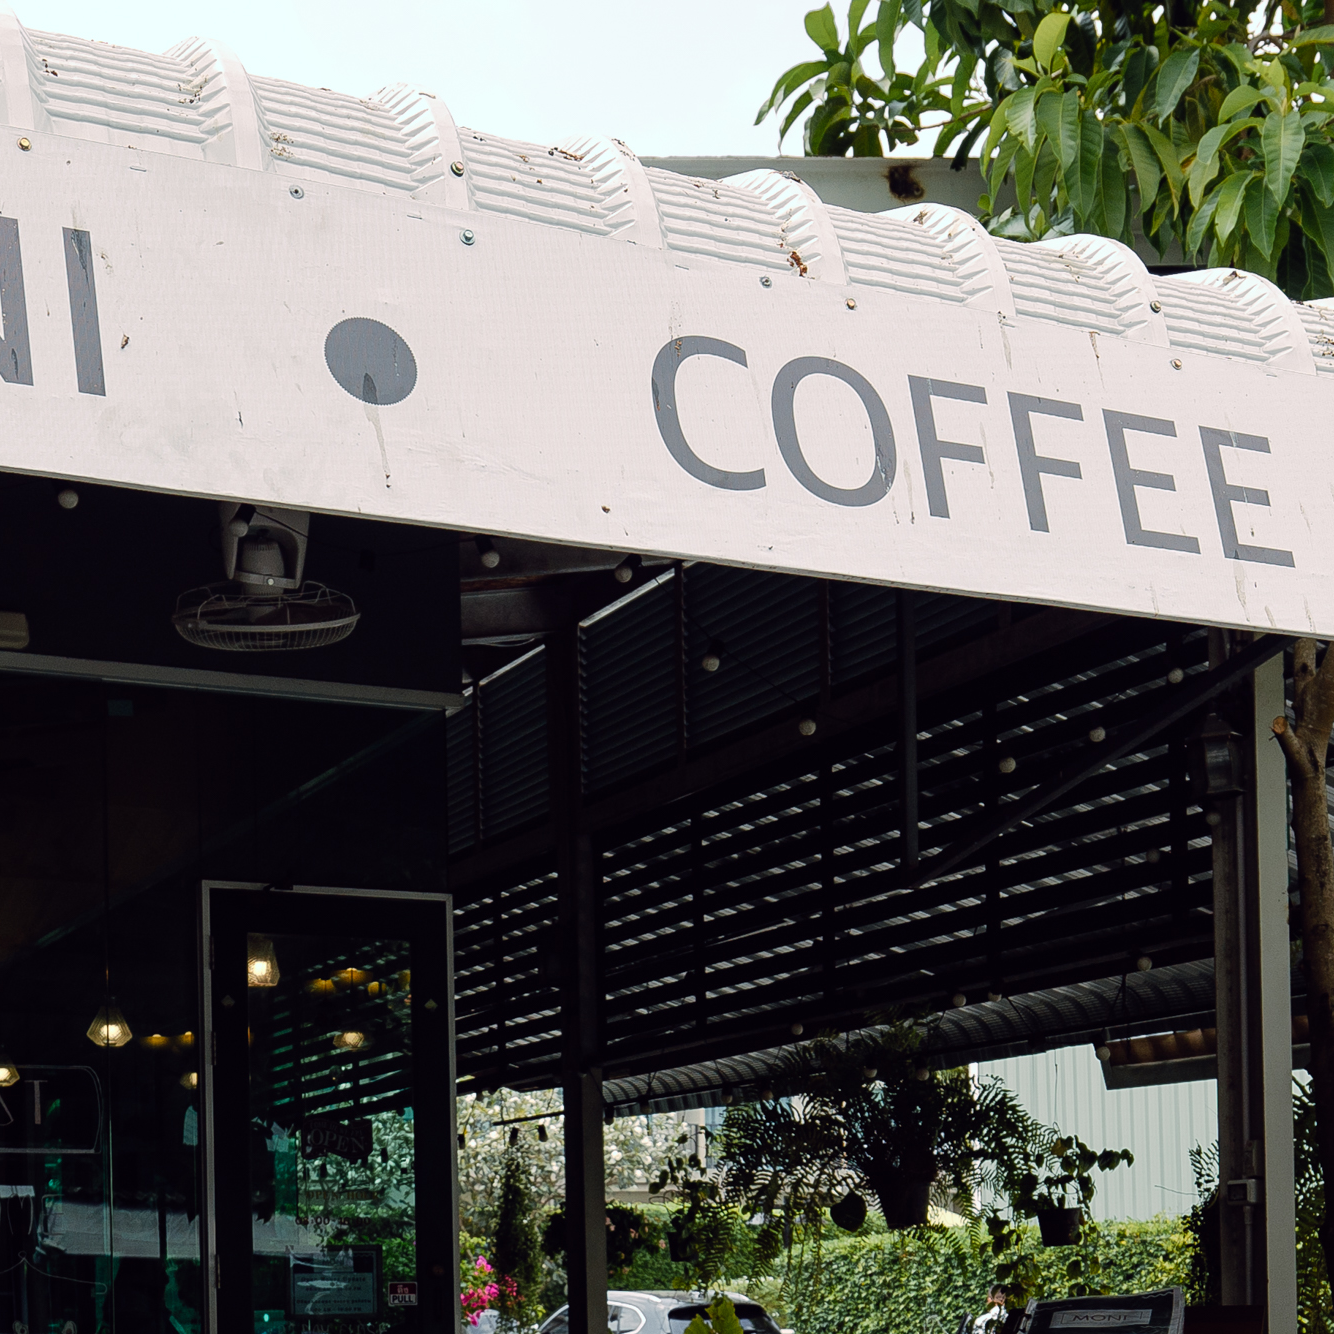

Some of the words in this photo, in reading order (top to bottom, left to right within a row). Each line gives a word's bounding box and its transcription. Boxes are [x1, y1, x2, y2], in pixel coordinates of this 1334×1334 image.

[650, 335, 1297, 568] COFFEE
[310, 1128, 366, 1154] OPEN
[392, 1295, 413, 1303] PULL
[1072, 1313, 1128, 1322] MONI
